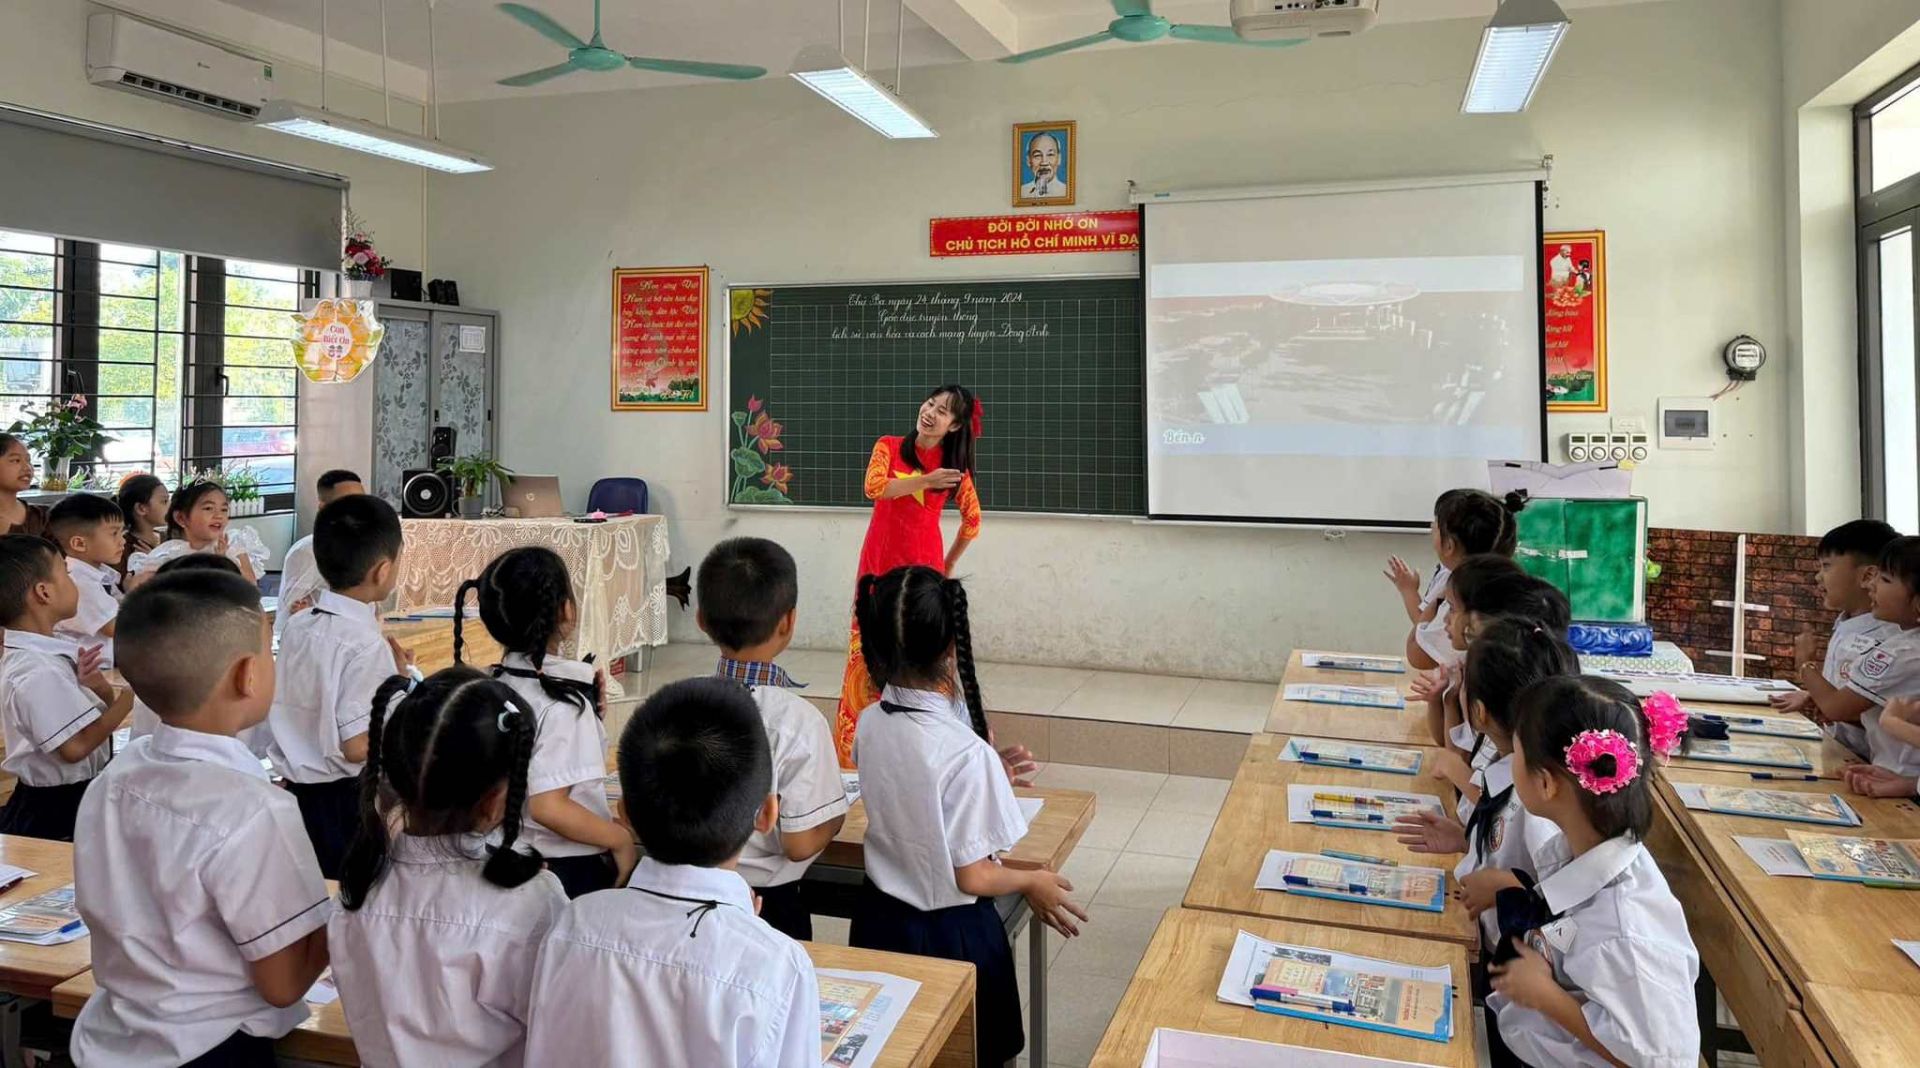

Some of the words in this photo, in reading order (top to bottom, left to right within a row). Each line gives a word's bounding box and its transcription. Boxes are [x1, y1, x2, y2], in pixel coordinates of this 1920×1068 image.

[987, 219, 1012, 233] ĐỜI
[1015, 218, 1040, 232] ĐỜI
[1044, 217, 1074, 231] NHỚ
[1077, 217, 1098, 230] ƠN
[945, 236, 973, 251] CHỦ
[976, 239, 1007, 252] TỊCH
[1010, 234, 1031, 249] HỒ
[1034, 236, 1059, 249] CHÍ
[1062, 235, 1098, 247] MINH
[1101, 232, 1116, 246] VĨ
[1118, 233, 1139, 247] ĐẠ
[1001, 292, 1022, 303] 2024
